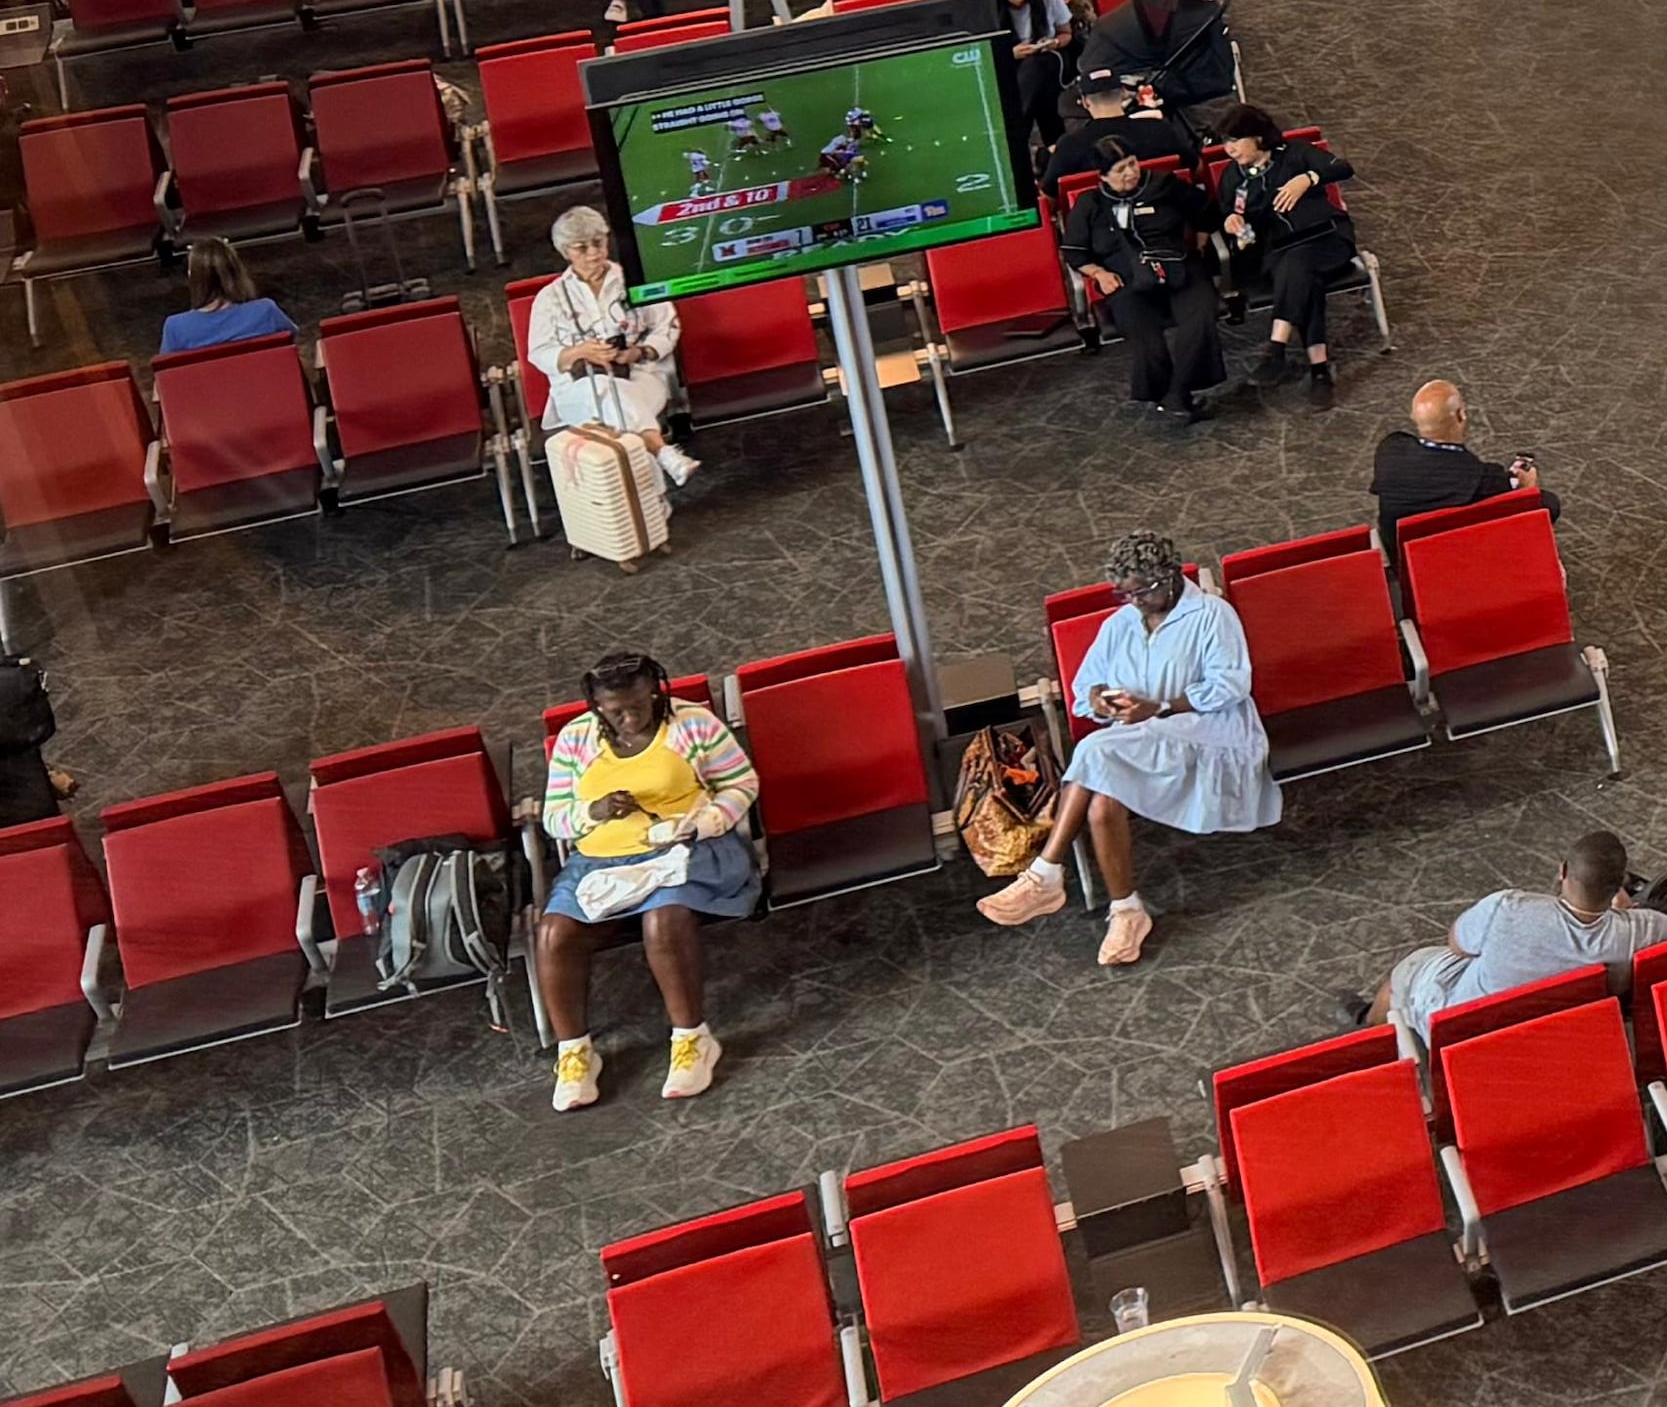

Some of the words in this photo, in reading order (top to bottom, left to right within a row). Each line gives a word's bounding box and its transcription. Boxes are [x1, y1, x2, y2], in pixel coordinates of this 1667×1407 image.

[675, 199, 721, 218] 2nd
[723, 194, 740, 208] &
[746, 188, 770, 203] 10
[856, 216, 872, 232] 21
